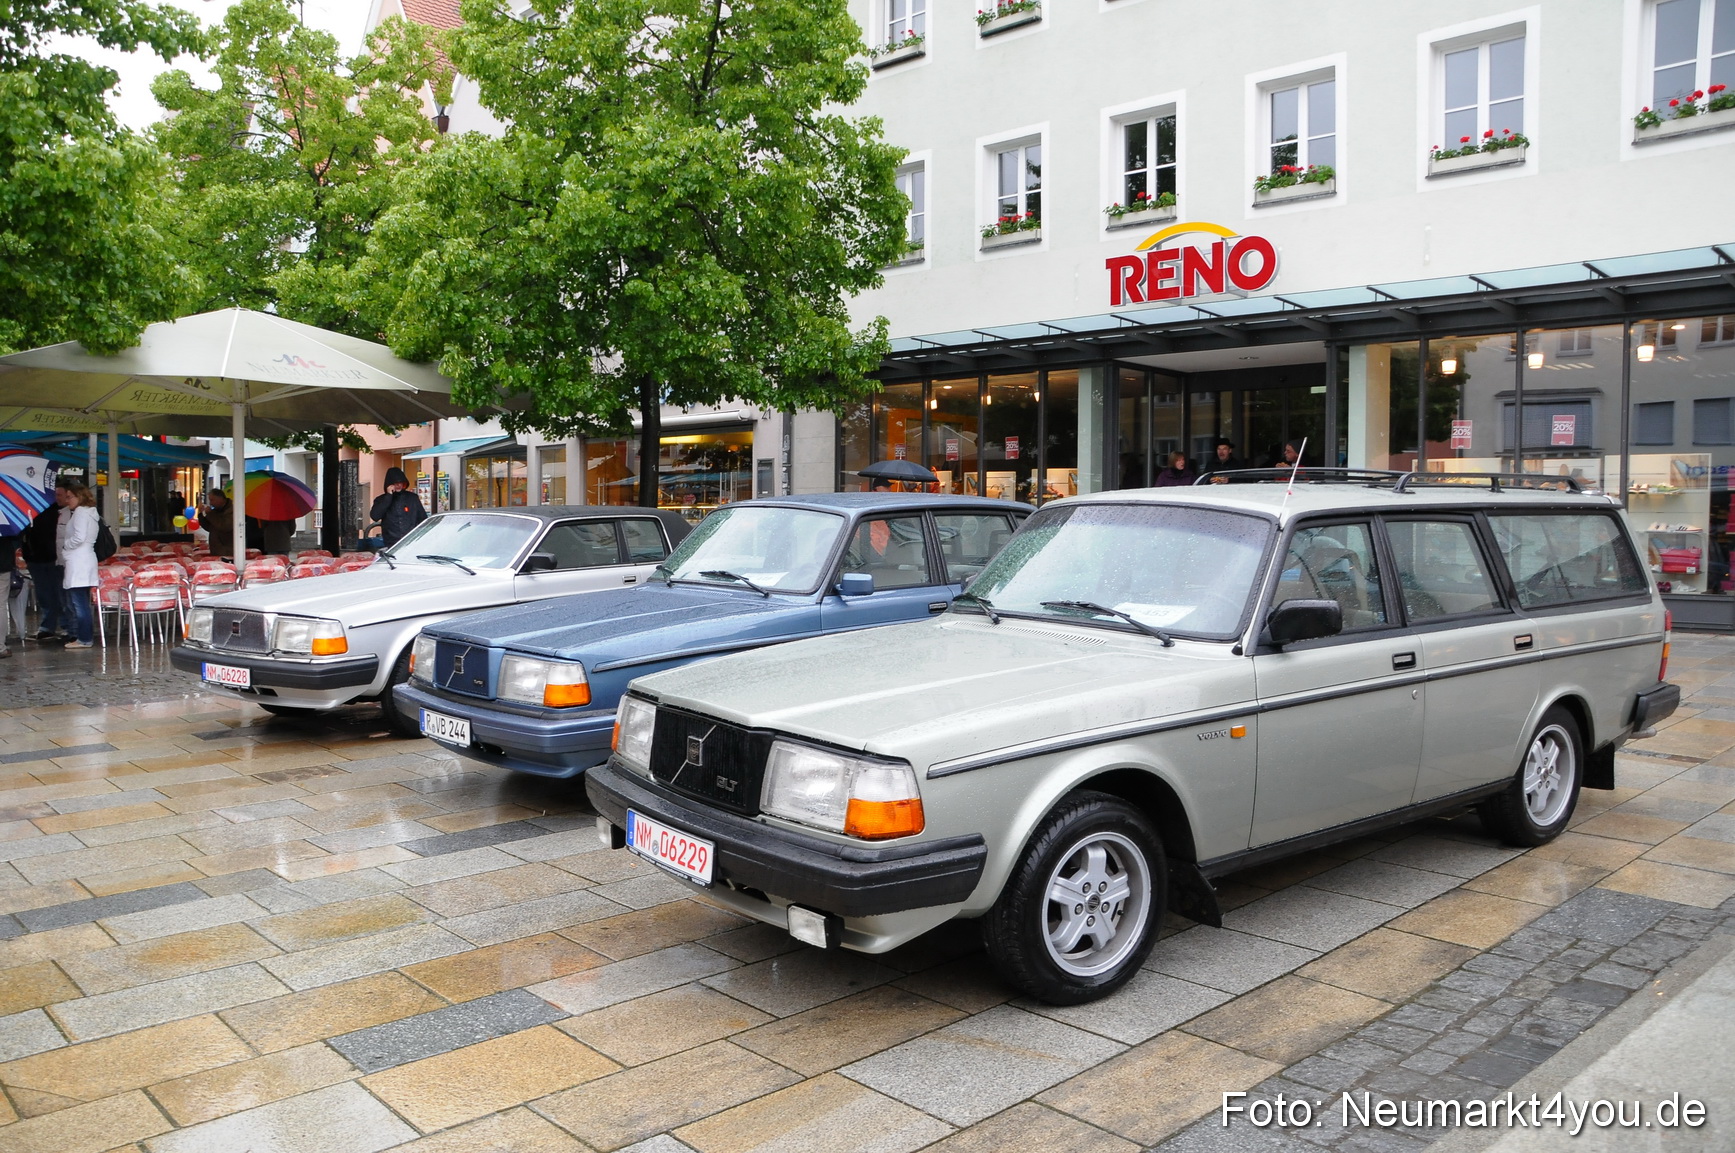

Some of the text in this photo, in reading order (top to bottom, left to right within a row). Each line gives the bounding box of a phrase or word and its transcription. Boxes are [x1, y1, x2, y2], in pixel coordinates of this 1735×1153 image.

[1105, 235, 1277, 307] RENO
[207, 665, 217, 680] NM
[221, 667, 248, 684] 06228
[426, 713, 432, 731] R
[435, 717, 447, 735] VB
[448, 720, 466, 741] 244
[1197, 729, 1228, 741] VOLVO
[716, 775, 739, 793] GLT
[636, 819, 653, 851] NM
[660, 830, 708, 874] 06229
